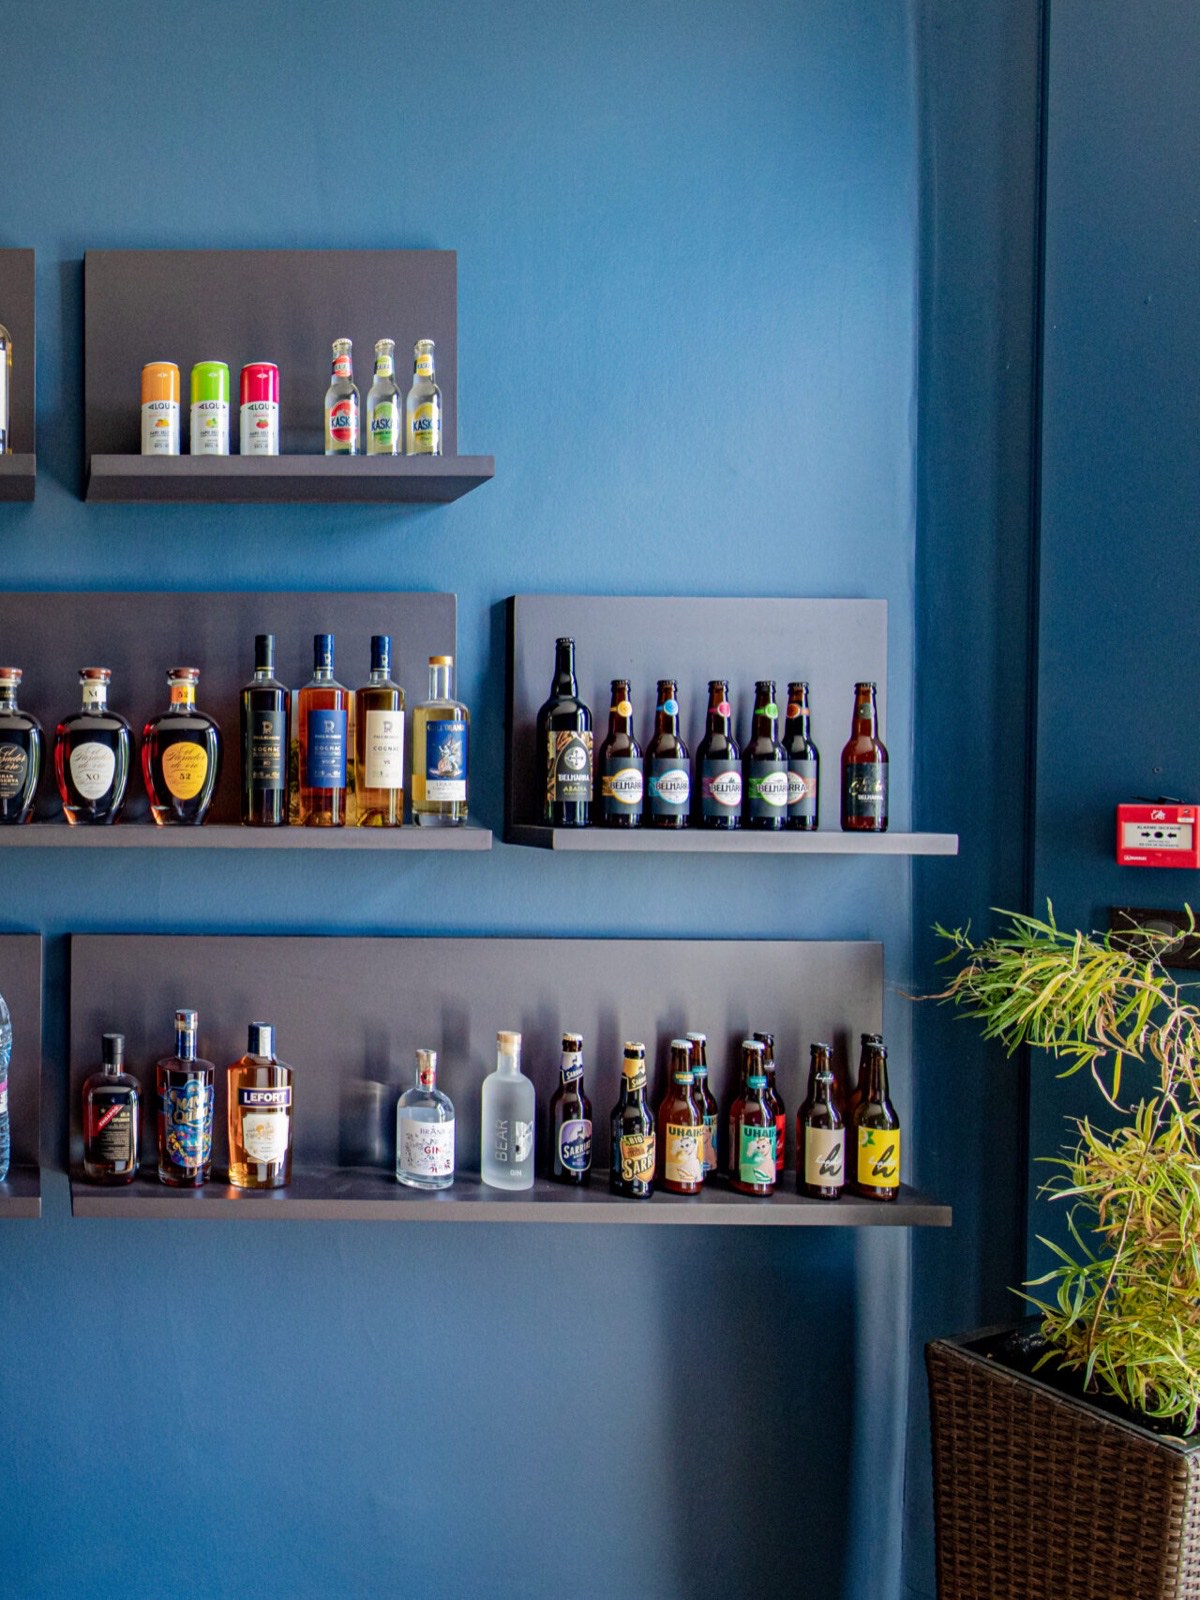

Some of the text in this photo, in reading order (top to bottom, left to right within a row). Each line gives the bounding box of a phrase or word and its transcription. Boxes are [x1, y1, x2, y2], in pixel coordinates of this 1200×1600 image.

[332, 417, 355, 428] KASK
[413, 418, 436, 432] KASK
[244, 1091, 287, 1104] LEFORT
[629, 1136, 643, 1145] BIO
[424, 1146, 442, 1154] GIN
